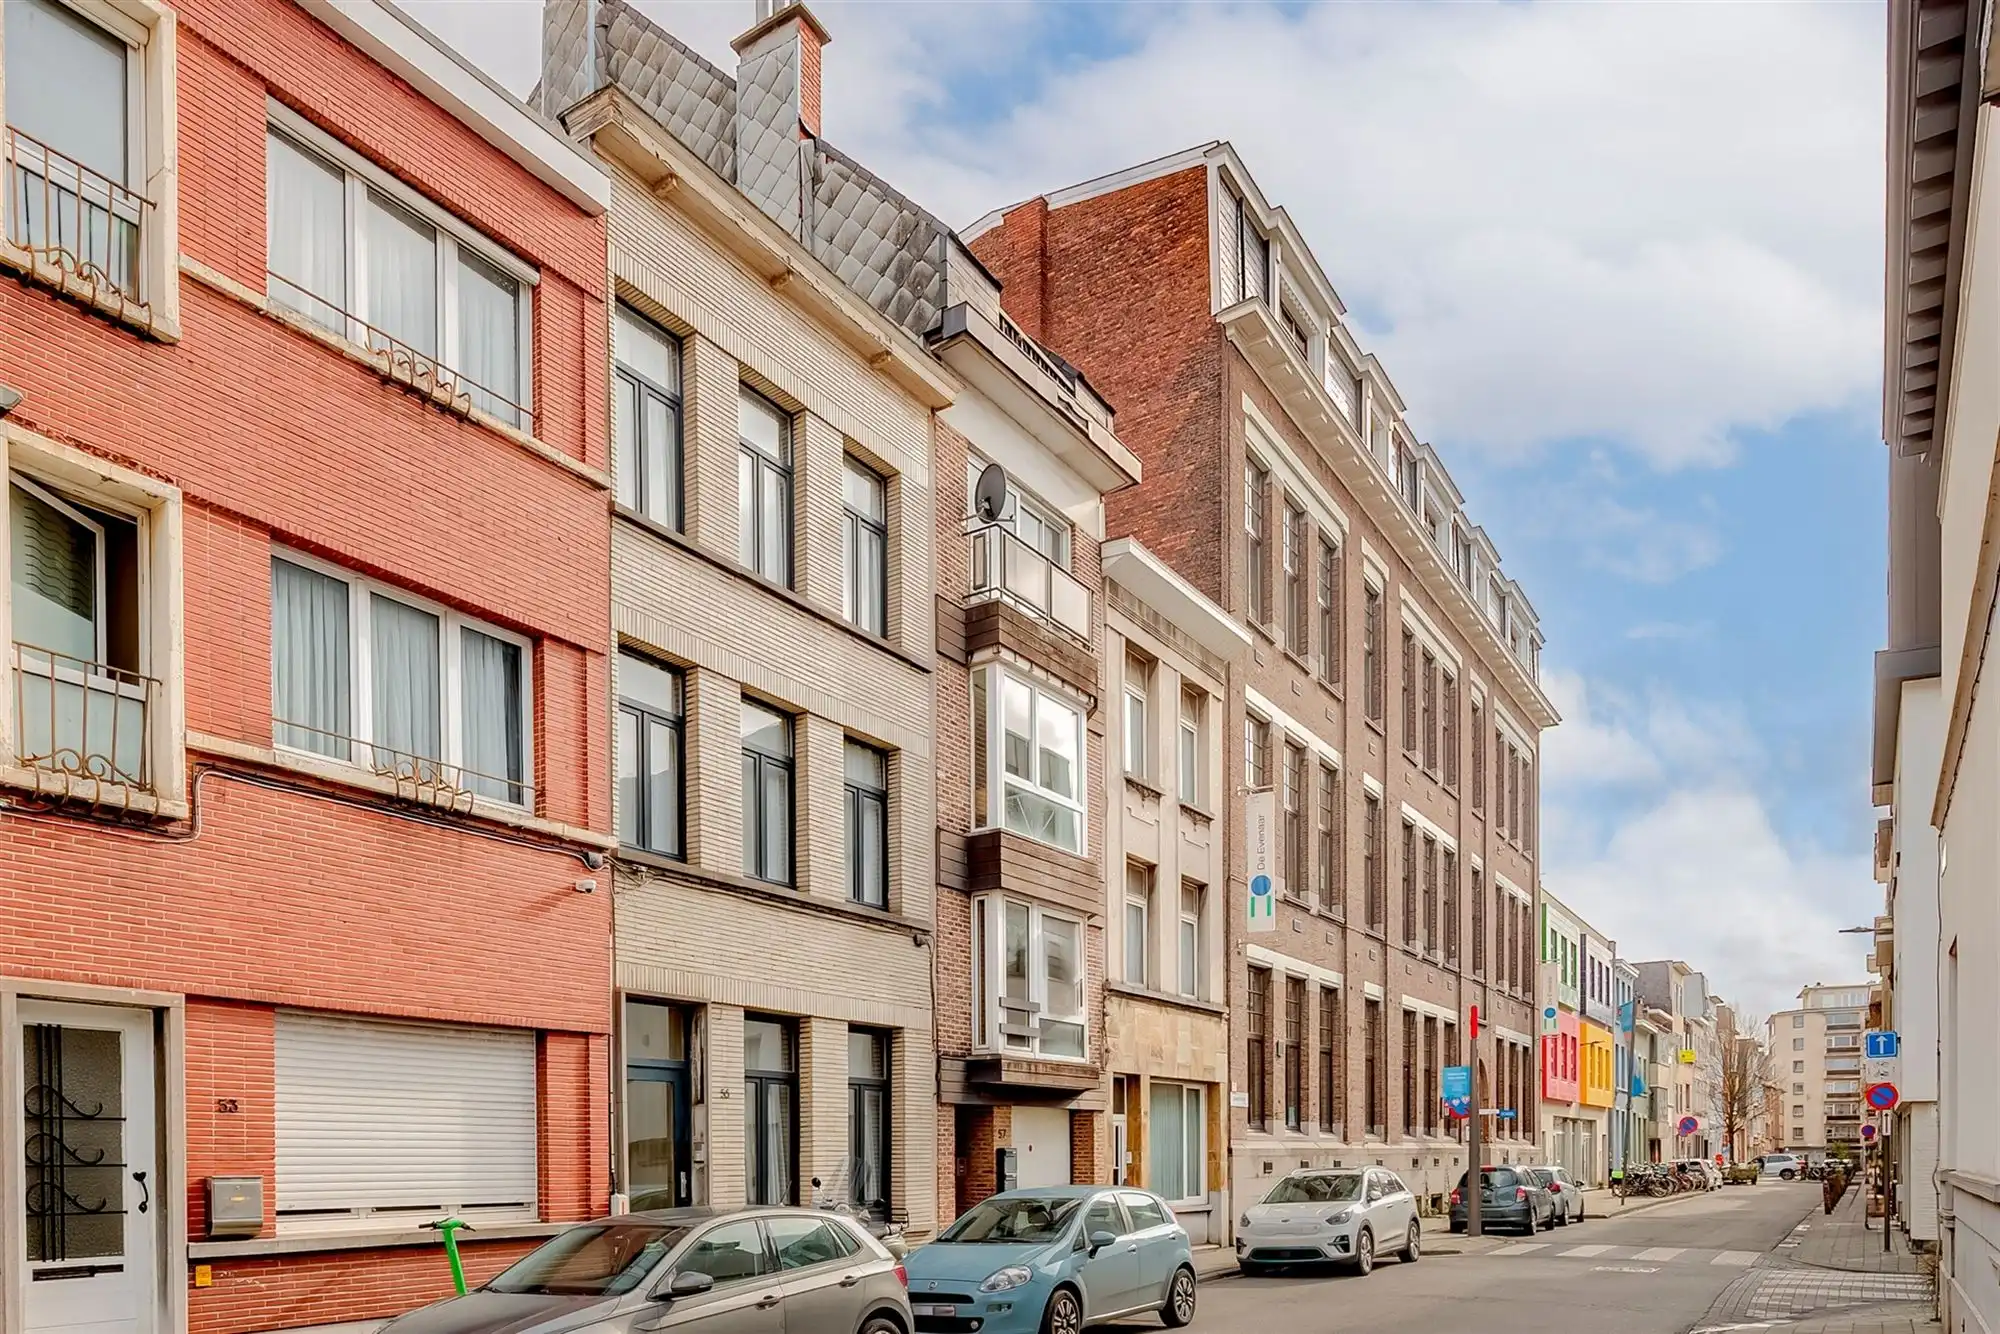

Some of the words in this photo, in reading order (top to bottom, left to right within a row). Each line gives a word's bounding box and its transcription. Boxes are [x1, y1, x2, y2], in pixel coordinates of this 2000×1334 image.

[1257, 814, 1265, 854] Evenaar
[1257, 855, 1265, 870] De
[217, 1099, 238, 1113] 53
[997, 1128, 1007, 1139] 57
